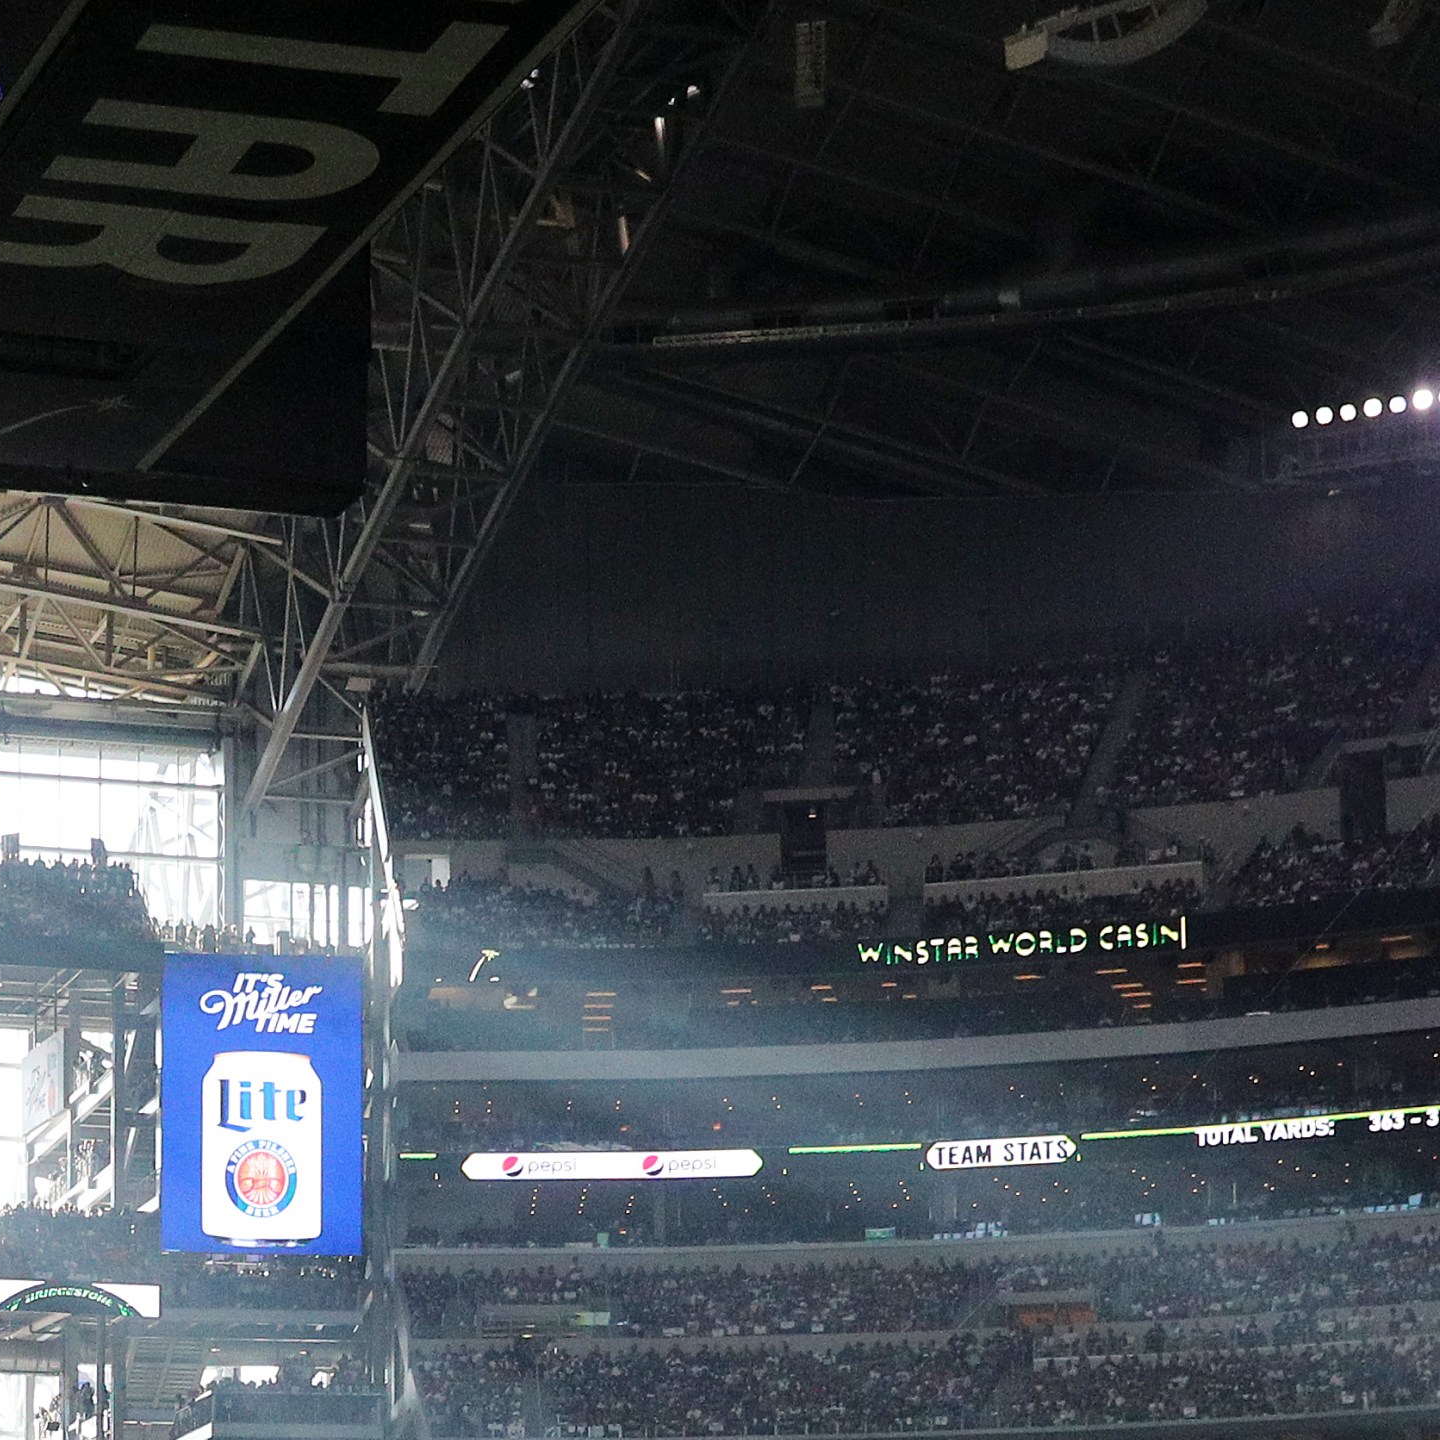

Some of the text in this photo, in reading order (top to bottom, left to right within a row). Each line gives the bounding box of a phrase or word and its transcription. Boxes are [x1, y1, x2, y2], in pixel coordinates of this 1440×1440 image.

[858, 935, 979, 965] WINSTAR
[989, 927, 1088, 957] WORLD
[232, 973, 284, 994] IT'S
[200, 985, 323, 1030] Miller
[255, 1013, 318, 1034] TIME
[217, 1079, 307, 1133] Lite
[1193, 1125, 1258, 1147] TOTAL
[1261, 1119, 1335, 1142] YARDS:
[1368, 1111, 1405, 1132] 363
[668, 1155, 717, 1174] pepsi
[936, 1139, 1070, 1165] TEAM STATS
[527, 1157, 577, 1175] pepsi
